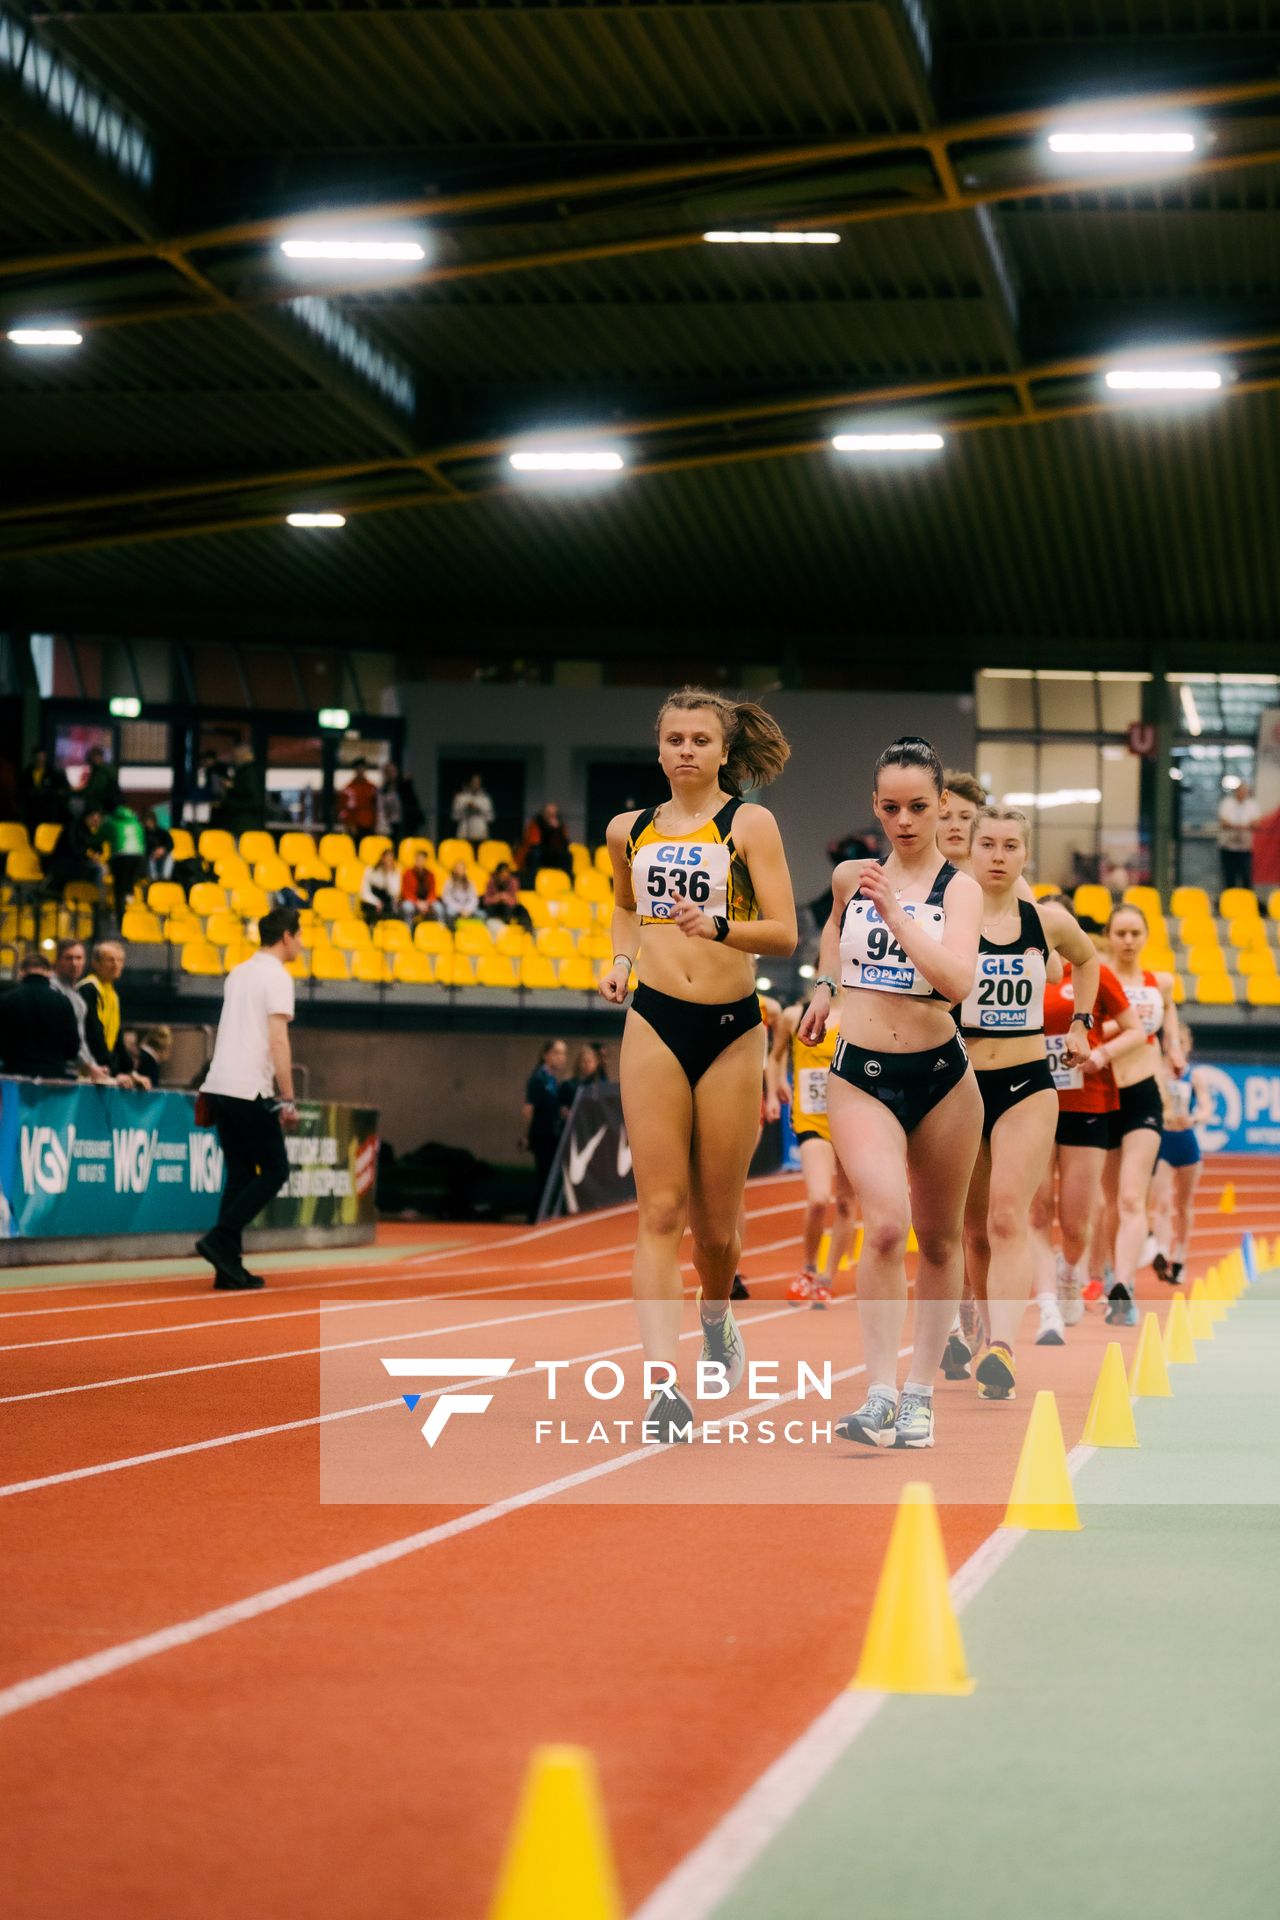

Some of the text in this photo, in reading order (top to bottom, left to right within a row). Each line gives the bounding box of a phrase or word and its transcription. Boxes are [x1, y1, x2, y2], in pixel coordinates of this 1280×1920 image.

[656, 845, 702, 866] GLS
[647, 866, 710, 903] 536
[881, 968, 912, 982] PLAN
[982, 958, 1025, 976] GLS
[977, 979, 1032, 1006] 200
[1000, 1012, 1025, 1021] PLAN
